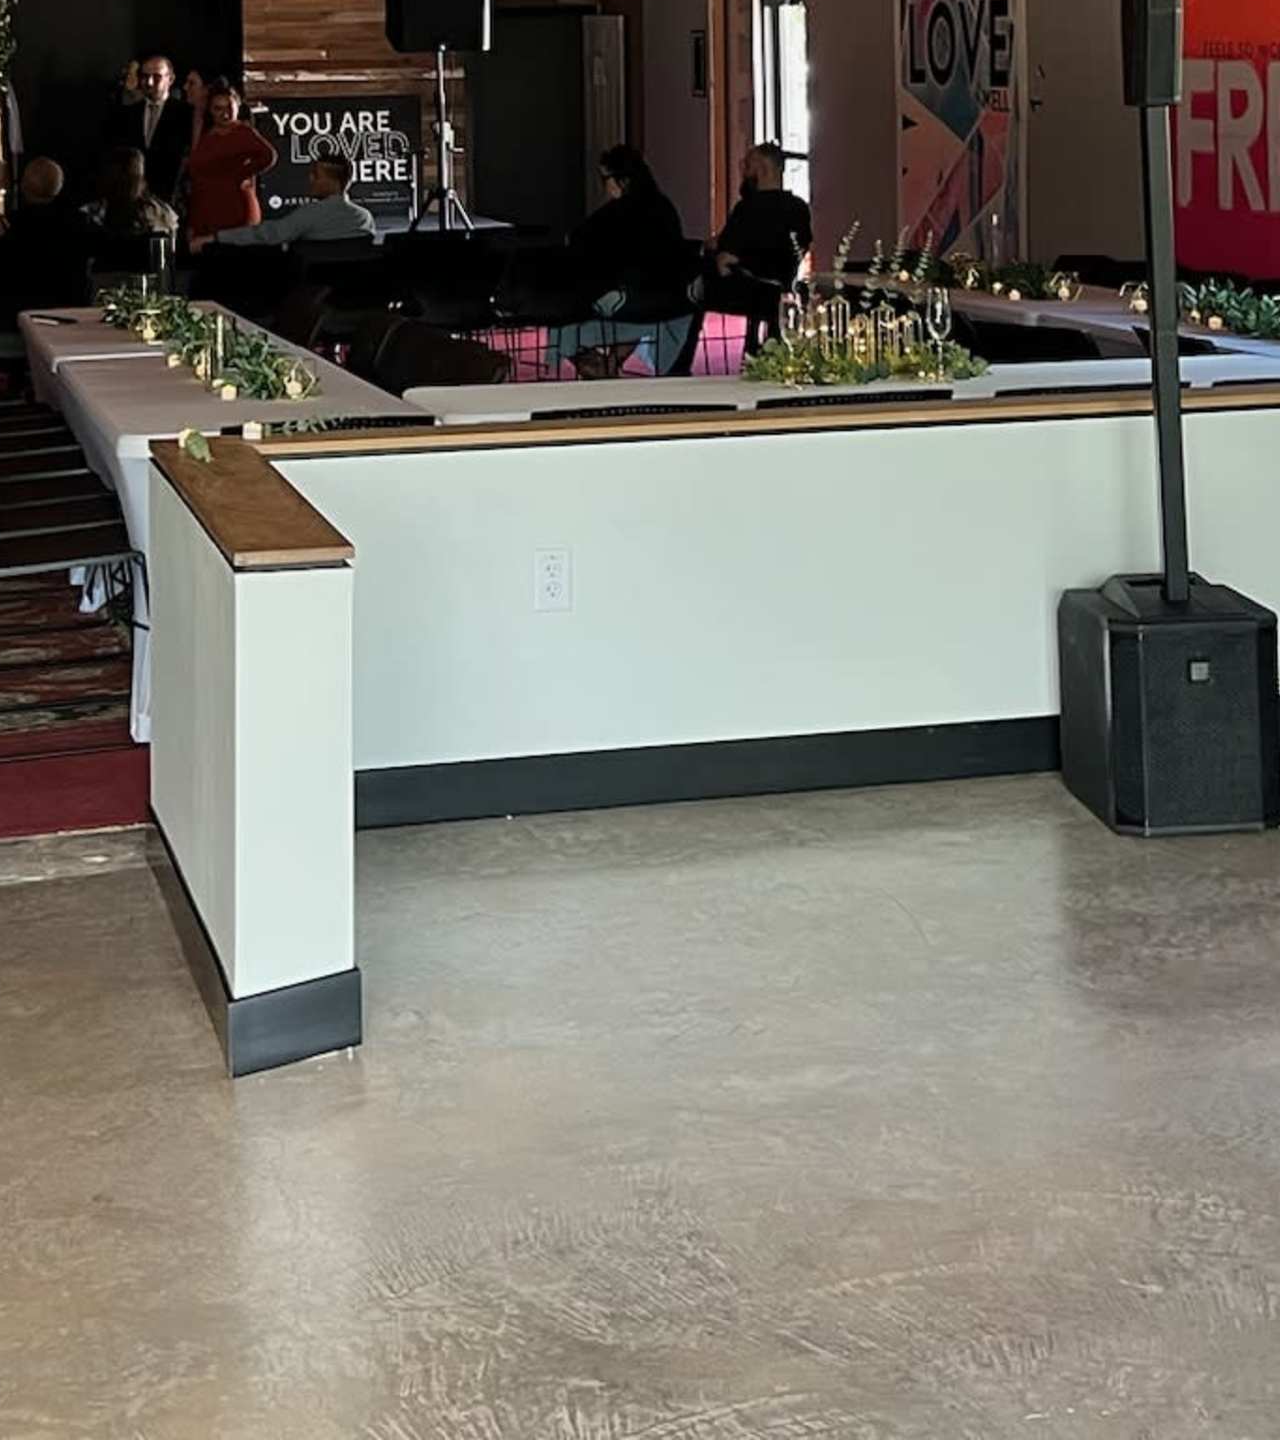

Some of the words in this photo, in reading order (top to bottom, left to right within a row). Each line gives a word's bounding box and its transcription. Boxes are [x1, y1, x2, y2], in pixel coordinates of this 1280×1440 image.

[273, 112, 331, 135] YOU
[340, 110, 390, 132] ARE
[291, 131, 409, 163] LOVED
